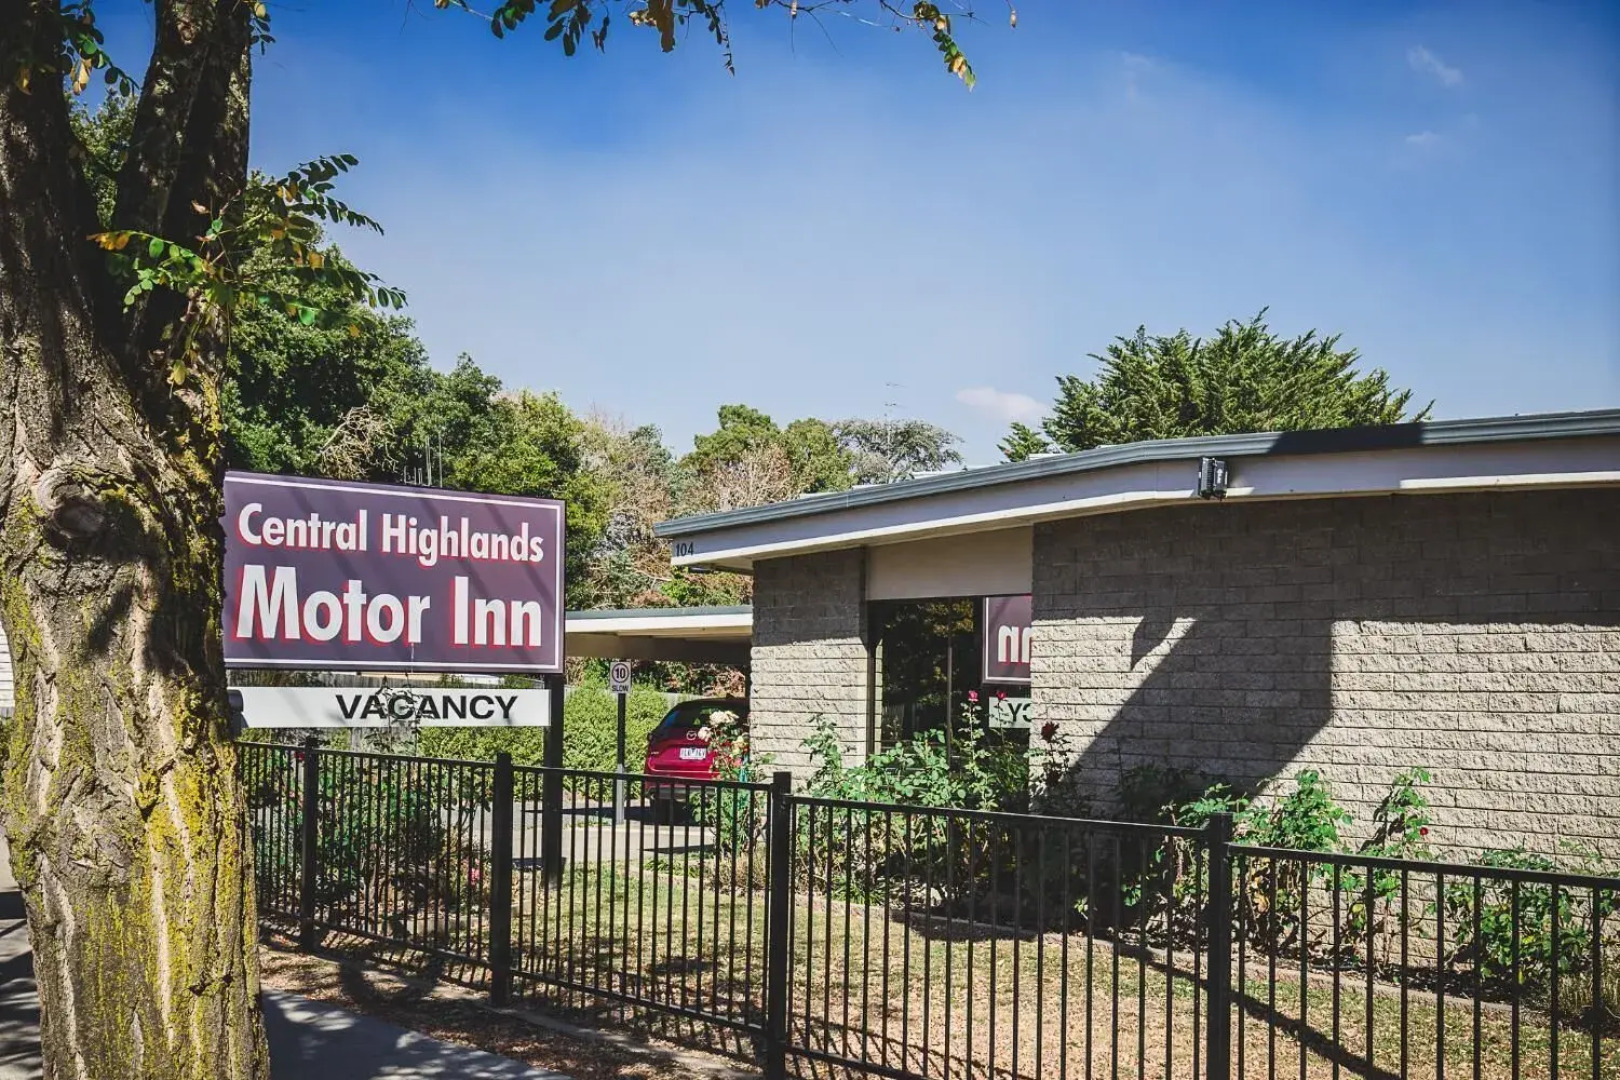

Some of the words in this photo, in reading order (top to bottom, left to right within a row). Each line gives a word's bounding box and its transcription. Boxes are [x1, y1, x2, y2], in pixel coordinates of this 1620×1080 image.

[238, 502, 367, 552] Central
[382, 512, 545, 567] Highlands
[675, 541, 694, 557] 104
[236, 564, 431, 643] Motor
[453, 575, 542, 647] Inn
[614, 667, 626, 679] 10
[611, 684, 629, 692] SLOW
[335, 694, 518, 720] VACANCY
